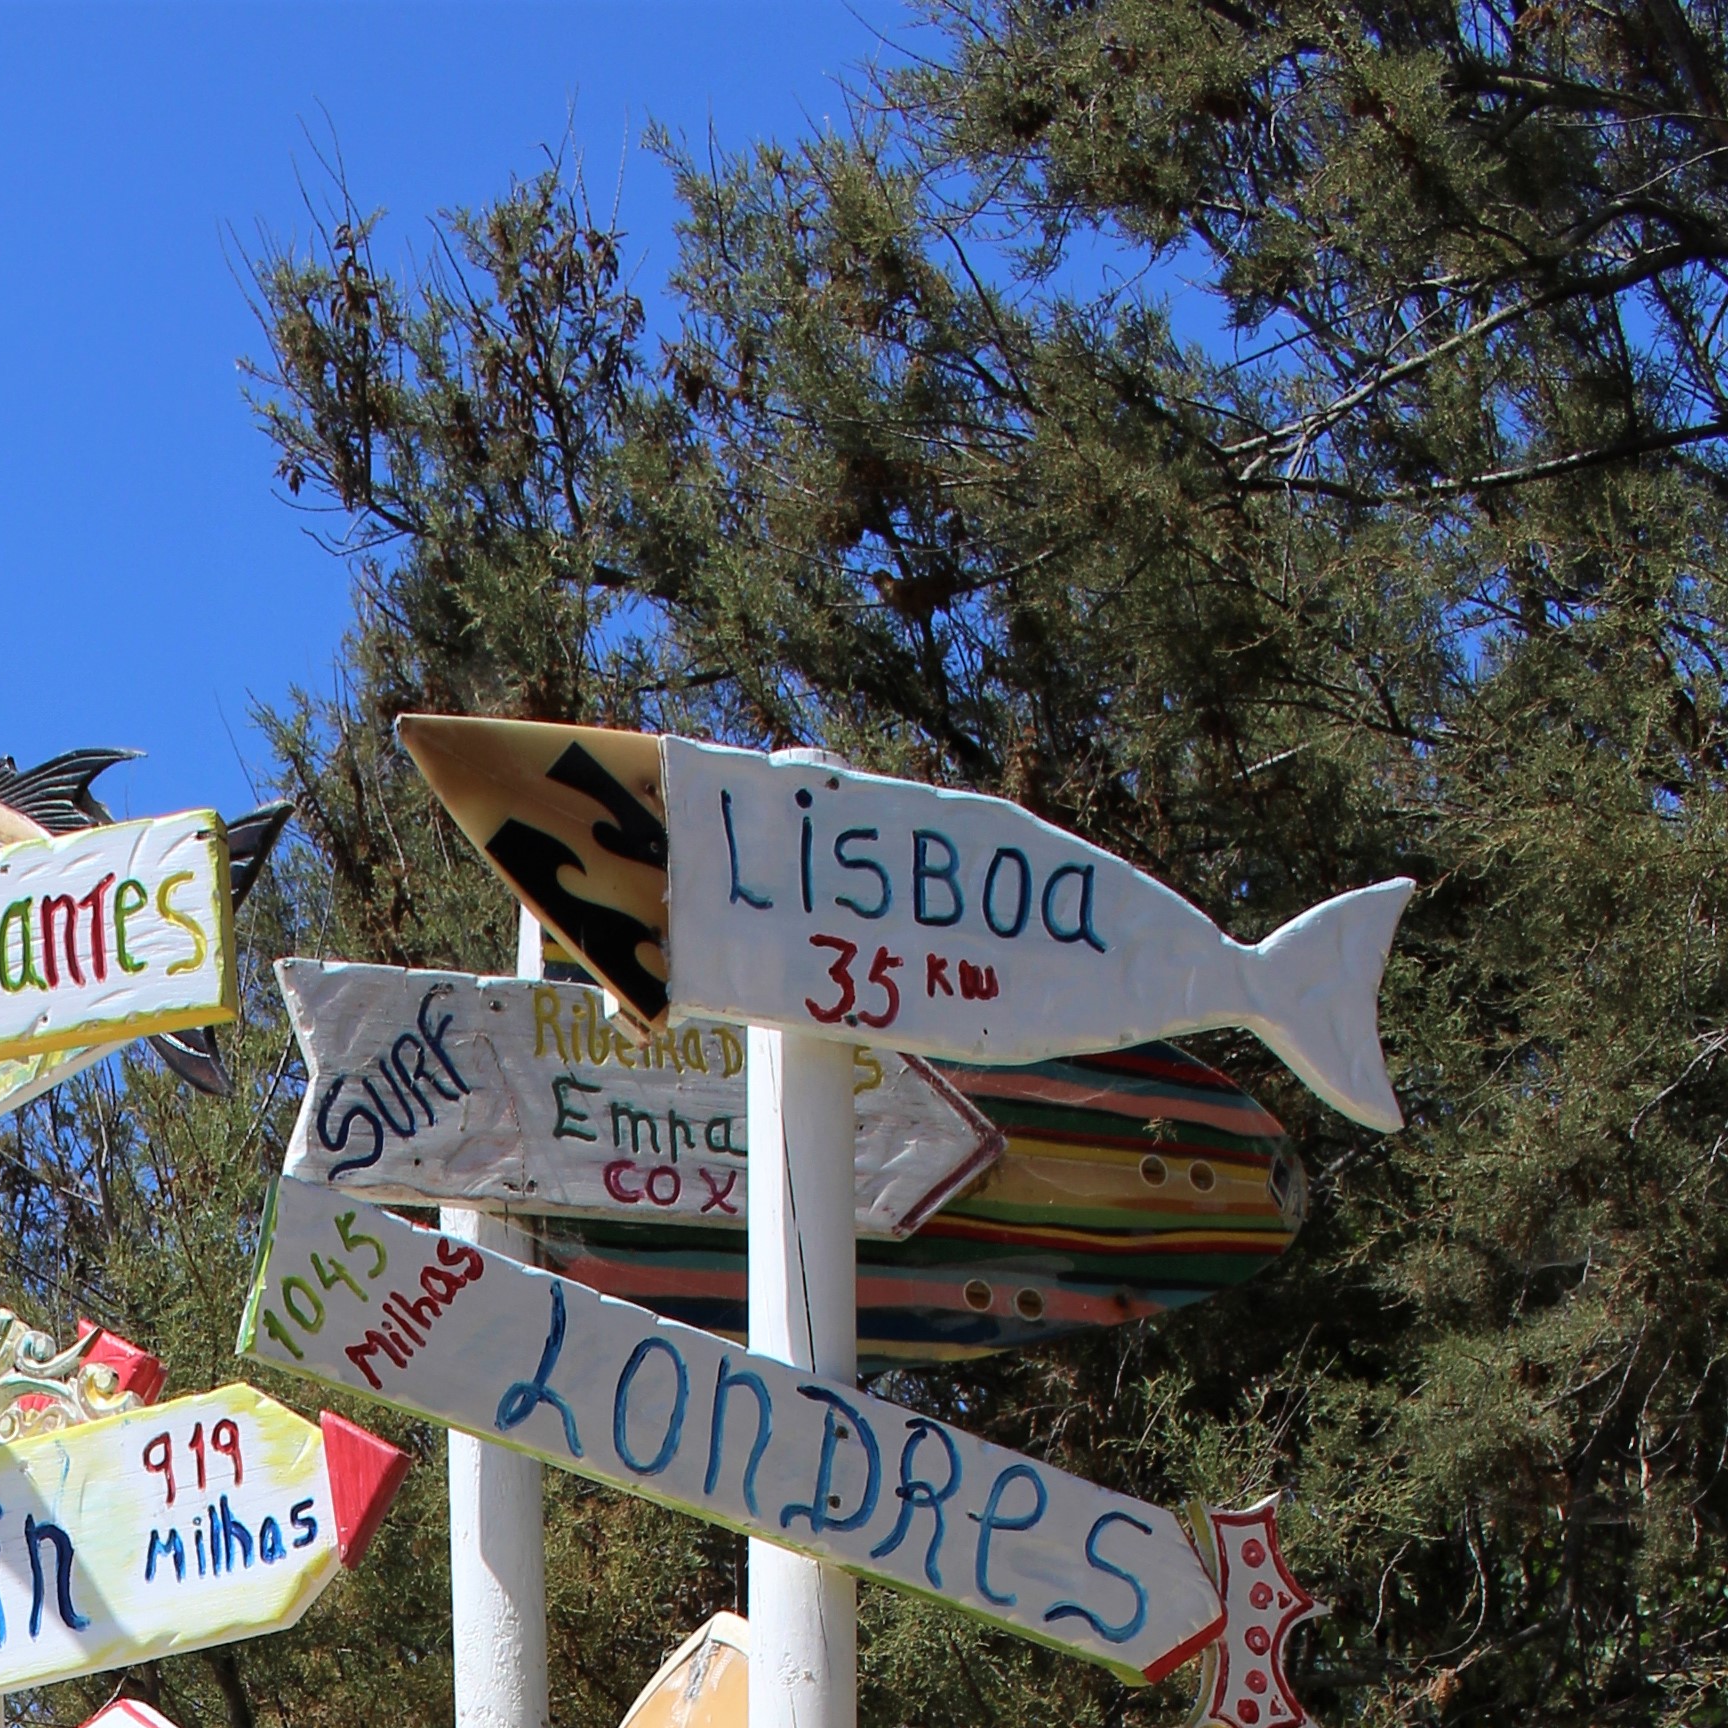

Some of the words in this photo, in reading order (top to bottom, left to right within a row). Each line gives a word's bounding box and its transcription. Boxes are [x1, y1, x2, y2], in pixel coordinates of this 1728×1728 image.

[316, 981, 471, 1180] SURF
[262, 1208, 389, 1361] 1045
[346, 1235, 485, 1388] Milhas
[143, 1417, 244, 1505] 919
[144, 1493, 319, 1584] Milhas
